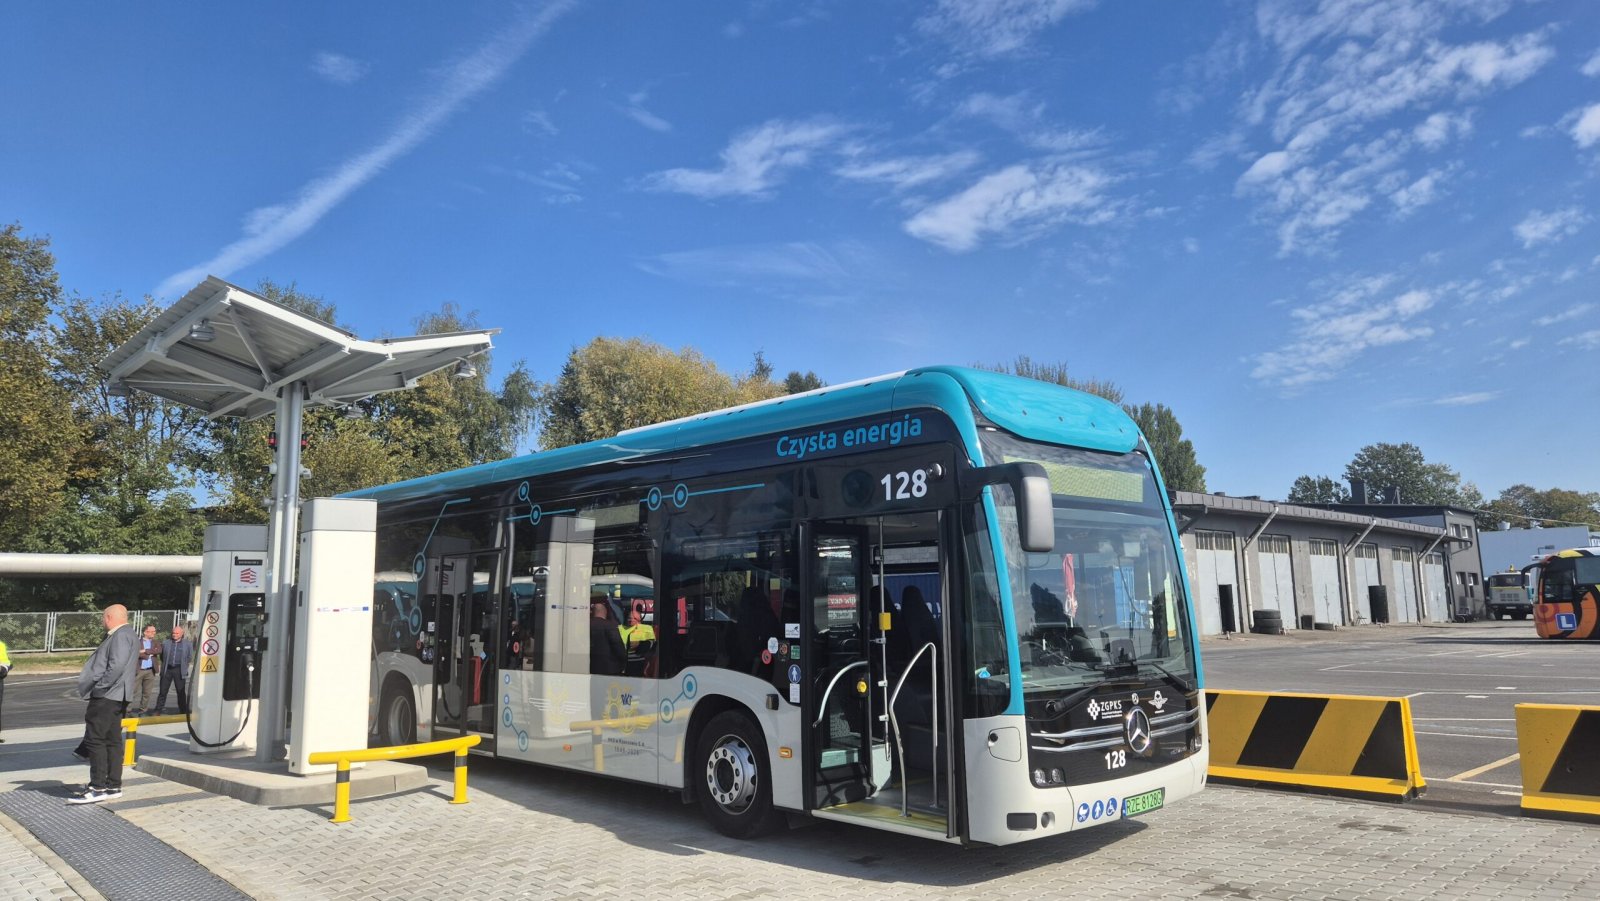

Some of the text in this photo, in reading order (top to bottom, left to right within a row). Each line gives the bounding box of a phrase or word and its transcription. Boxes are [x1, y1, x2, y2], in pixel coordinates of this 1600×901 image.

[776, 414, 922, 458] Czysta energia
[880, 468, 928, 501] 128
[1560, 616, 1573, 628] L
[1100, 700, 1122, 711] ZGPKS
[1105, 750, 1126, 769] 128
[1126, 797, 1141, 814] RZE
